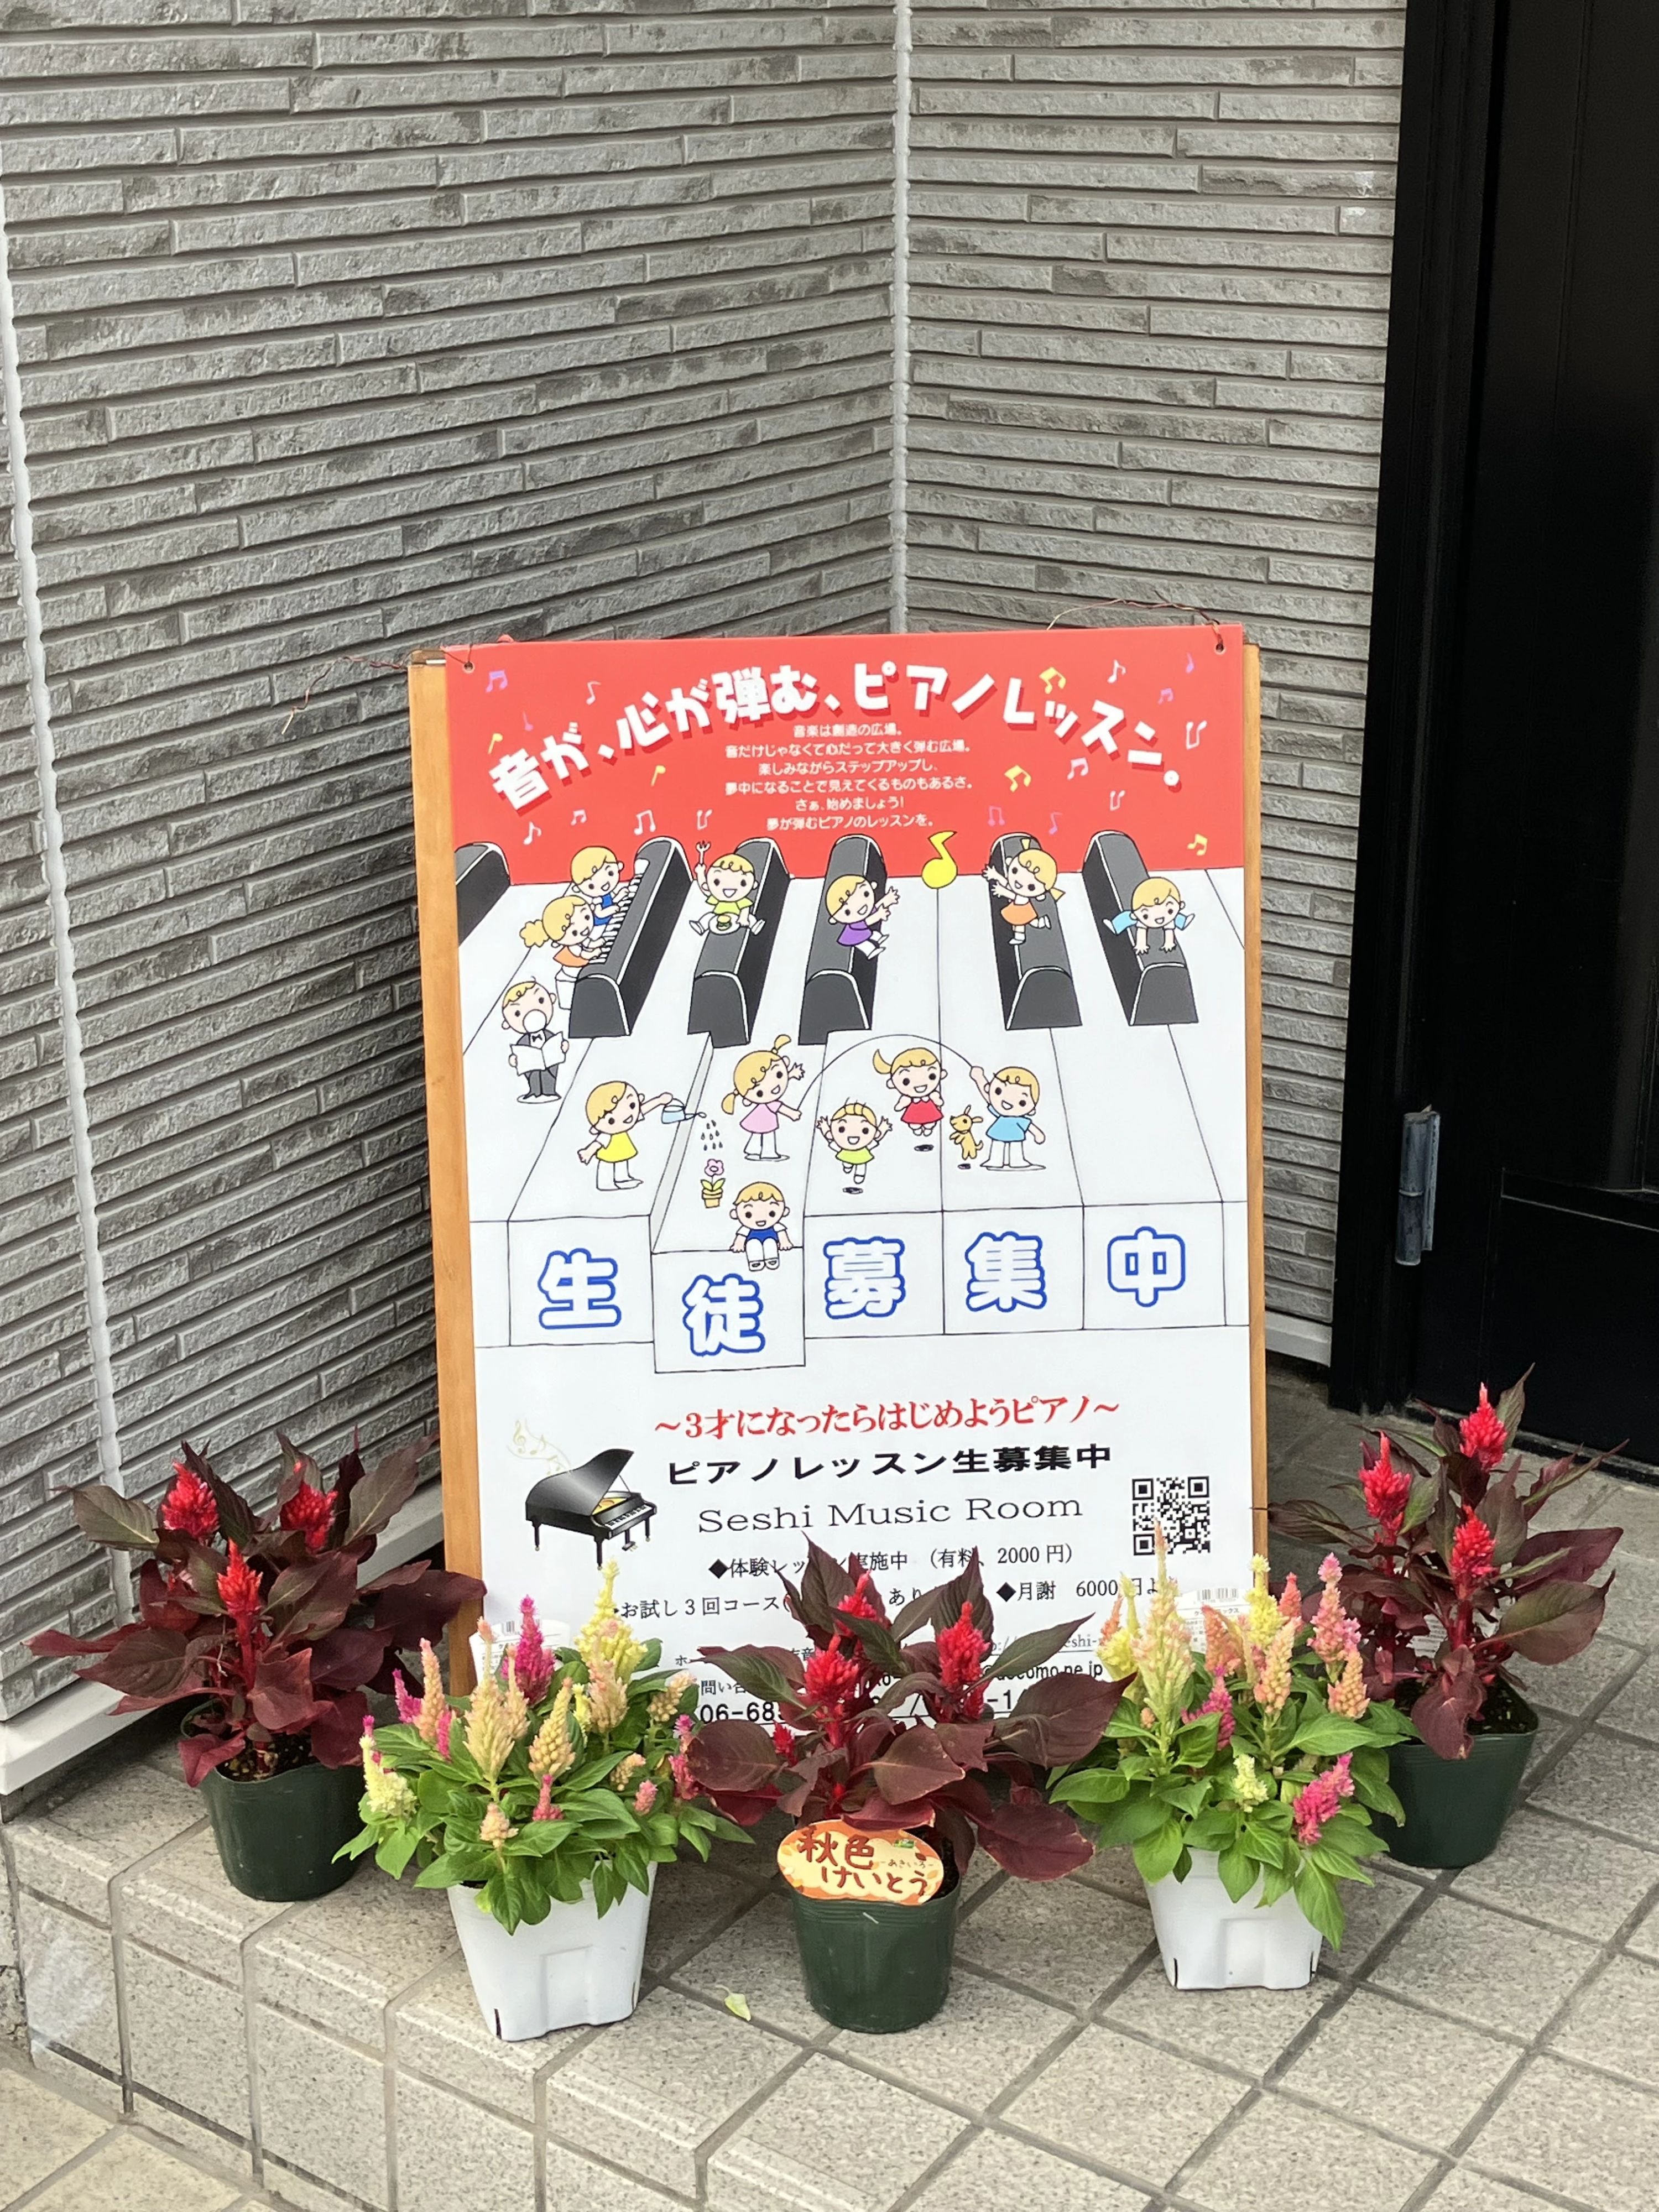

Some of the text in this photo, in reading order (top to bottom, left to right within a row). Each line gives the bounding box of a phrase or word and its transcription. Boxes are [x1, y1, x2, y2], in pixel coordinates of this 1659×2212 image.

[794, 722, 902, 738] 音楽は創造の広場。
[725, 775, 972, 795] 夢中になることで見えてくるものもあるさ。
[766, 815, 933, 831] 夢が弾むピアノのレッスンを。
[669, 1443, 1111, 1485] ピアノレッスン生募集中
[699, 1498, 1083, 1533] Seshi Music Room
[797, 1825, 875, 1870] 秋色
[821, 1866, 928, 1897] けいとう
